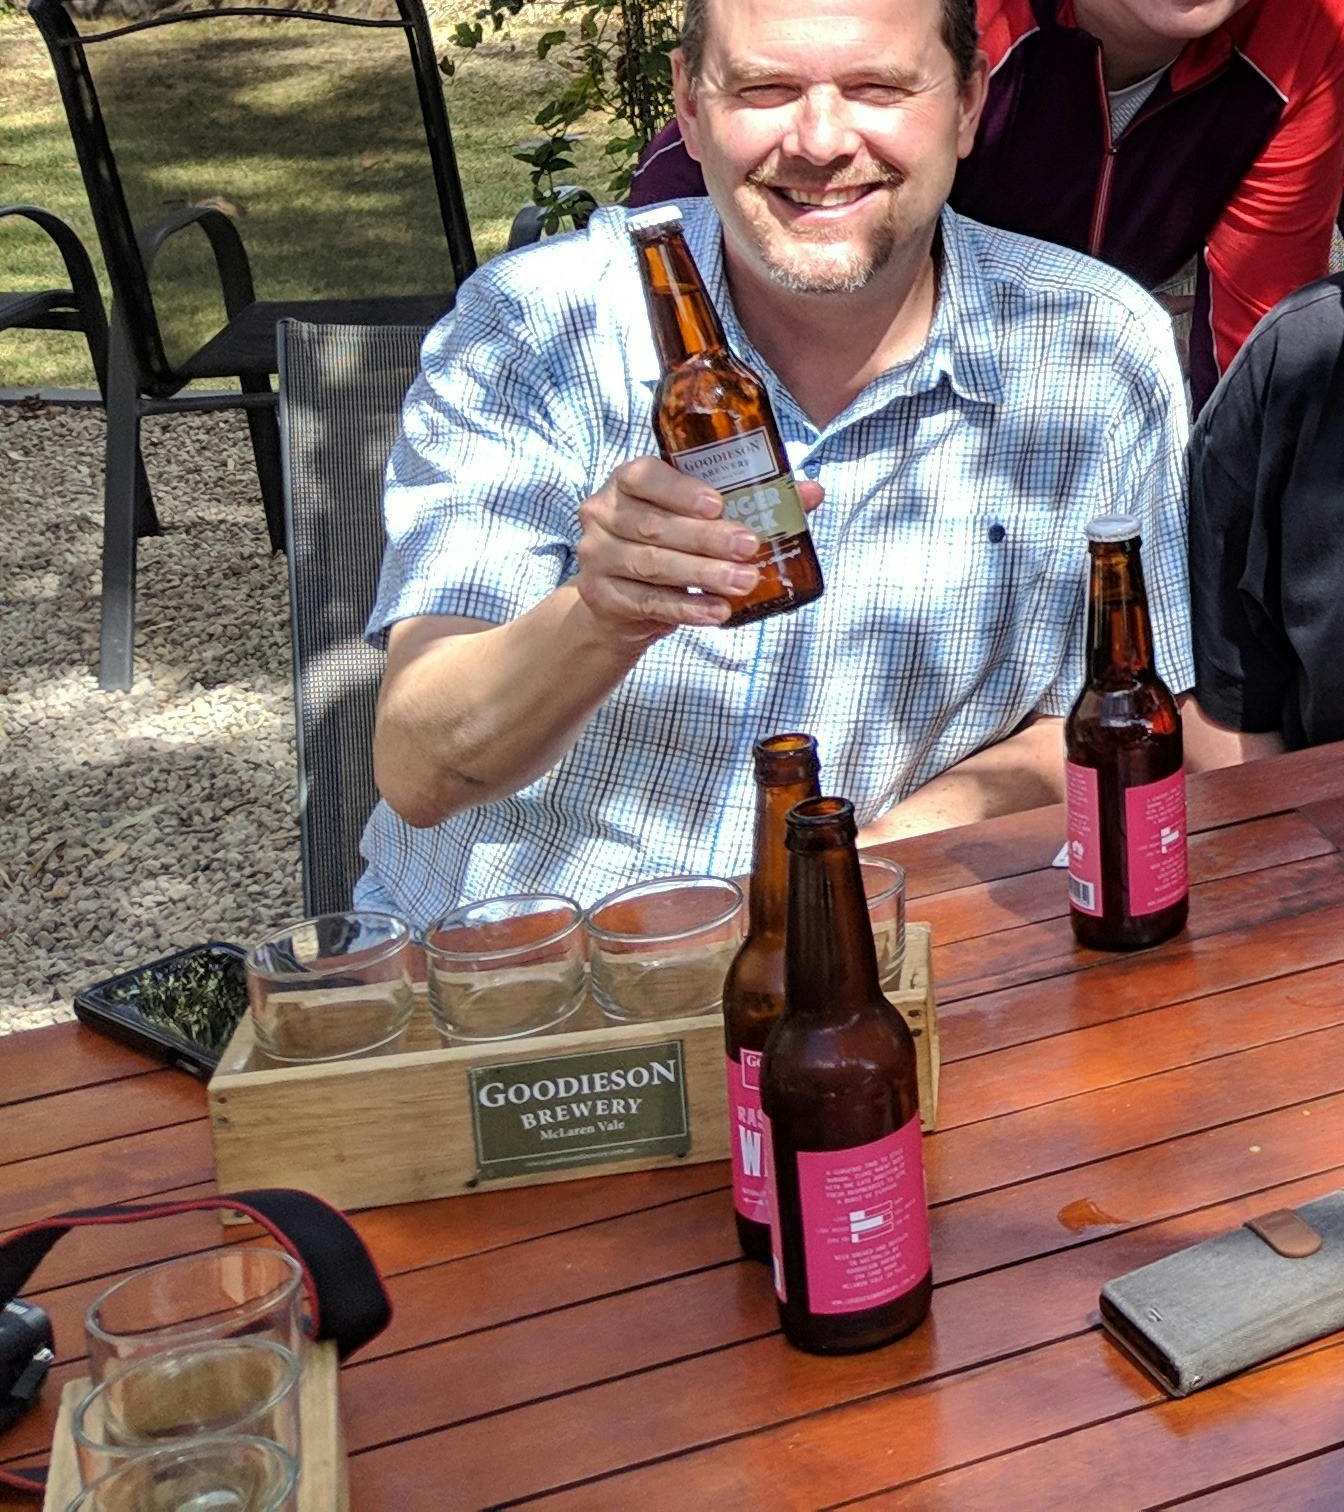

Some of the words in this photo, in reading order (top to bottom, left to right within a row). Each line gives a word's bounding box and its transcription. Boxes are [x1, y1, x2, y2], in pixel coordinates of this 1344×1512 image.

[722, 487, 782, 521] NGER
[478, 1059, 677, 1108] GOODIESON
[520, 1098, 643, 1130] BREWERY
[540, 1125, 596, 1141] McLaren
[597, 1120, 626, 1133] Vale
